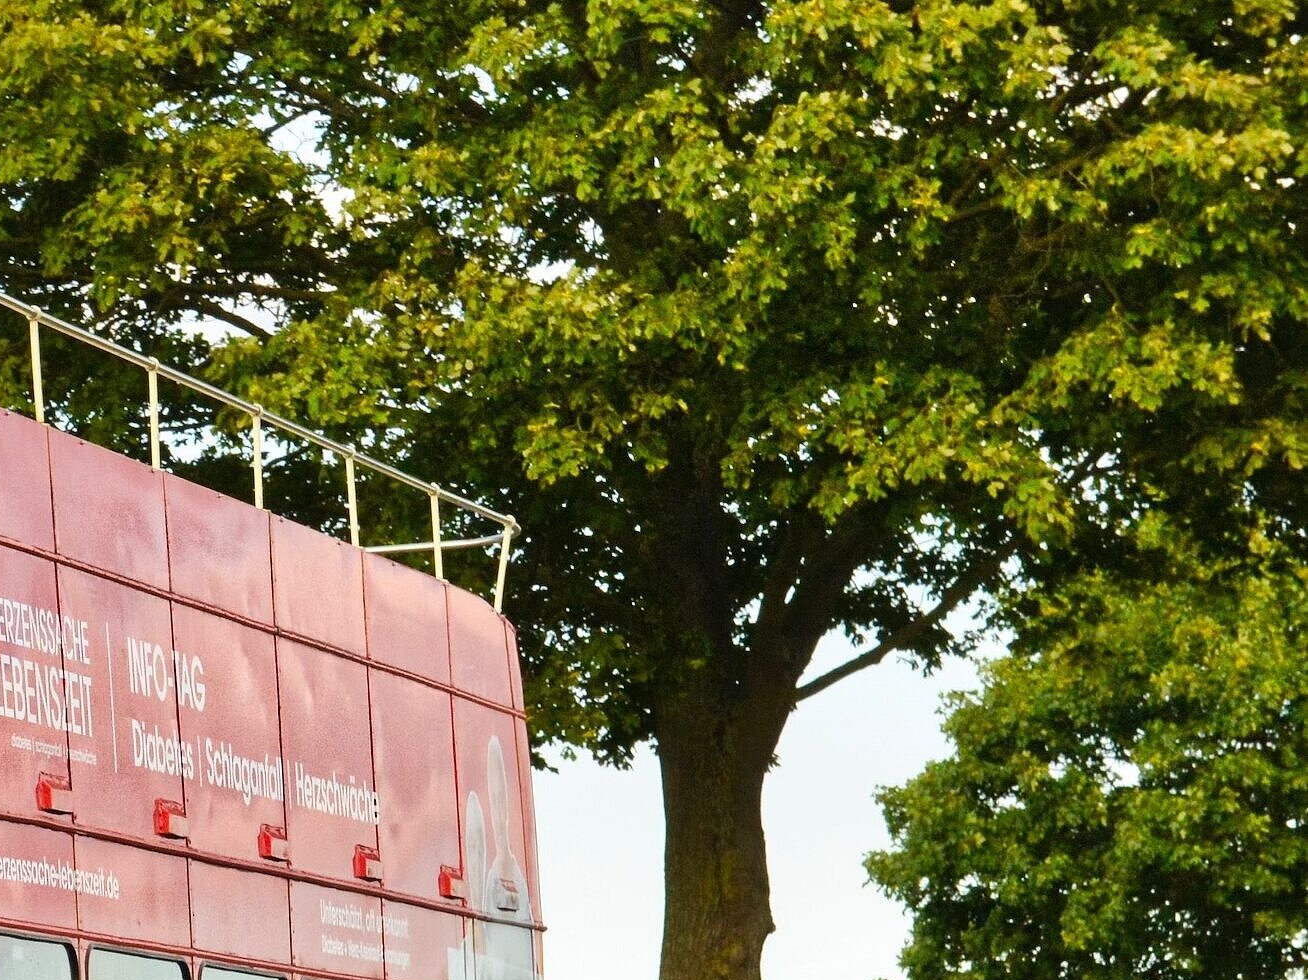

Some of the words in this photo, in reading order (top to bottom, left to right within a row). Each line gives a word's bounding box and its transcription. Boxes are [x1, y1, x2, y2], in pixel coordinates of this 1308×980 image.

[127, 637, 206, 712] INFO-TAG
[131, 719, 195, 780] Diabetes
[205, 737, 284, 806] Schlaganfall
[294, 762, 380, 824] Herzschwäche
